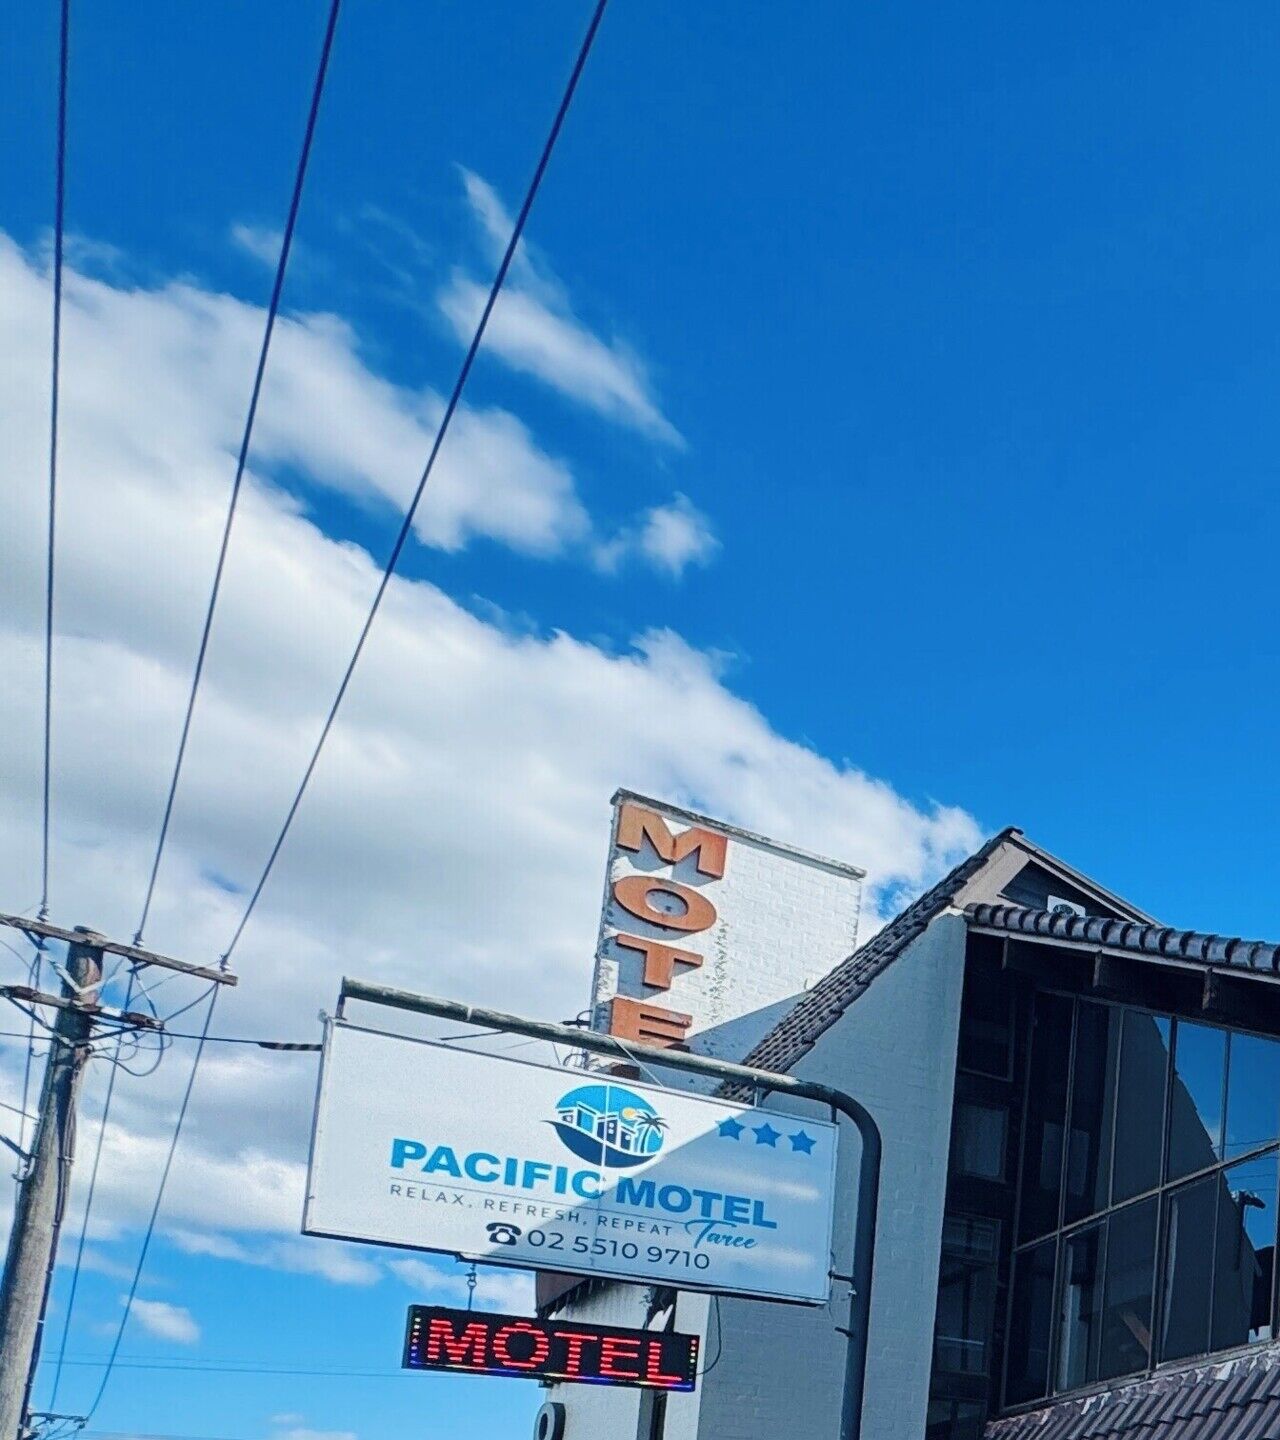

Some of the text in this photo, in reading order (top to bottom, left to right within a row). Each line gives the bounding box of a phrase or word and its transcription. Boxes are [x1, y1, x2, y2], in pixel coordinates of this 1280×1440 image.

[609, 804, 728, 1080] MOTE
[390, 1138, 778, 1229] PACIFIC MOTEL
[390, 1184, 672, 1236] RELAX, REFRESH, REPEAT
[528, 1230, 710, 1270] 02 5510 9710
[684, 1219, 758, 1249] Taree
[427, 1318, 683, 1382] MOTEL
